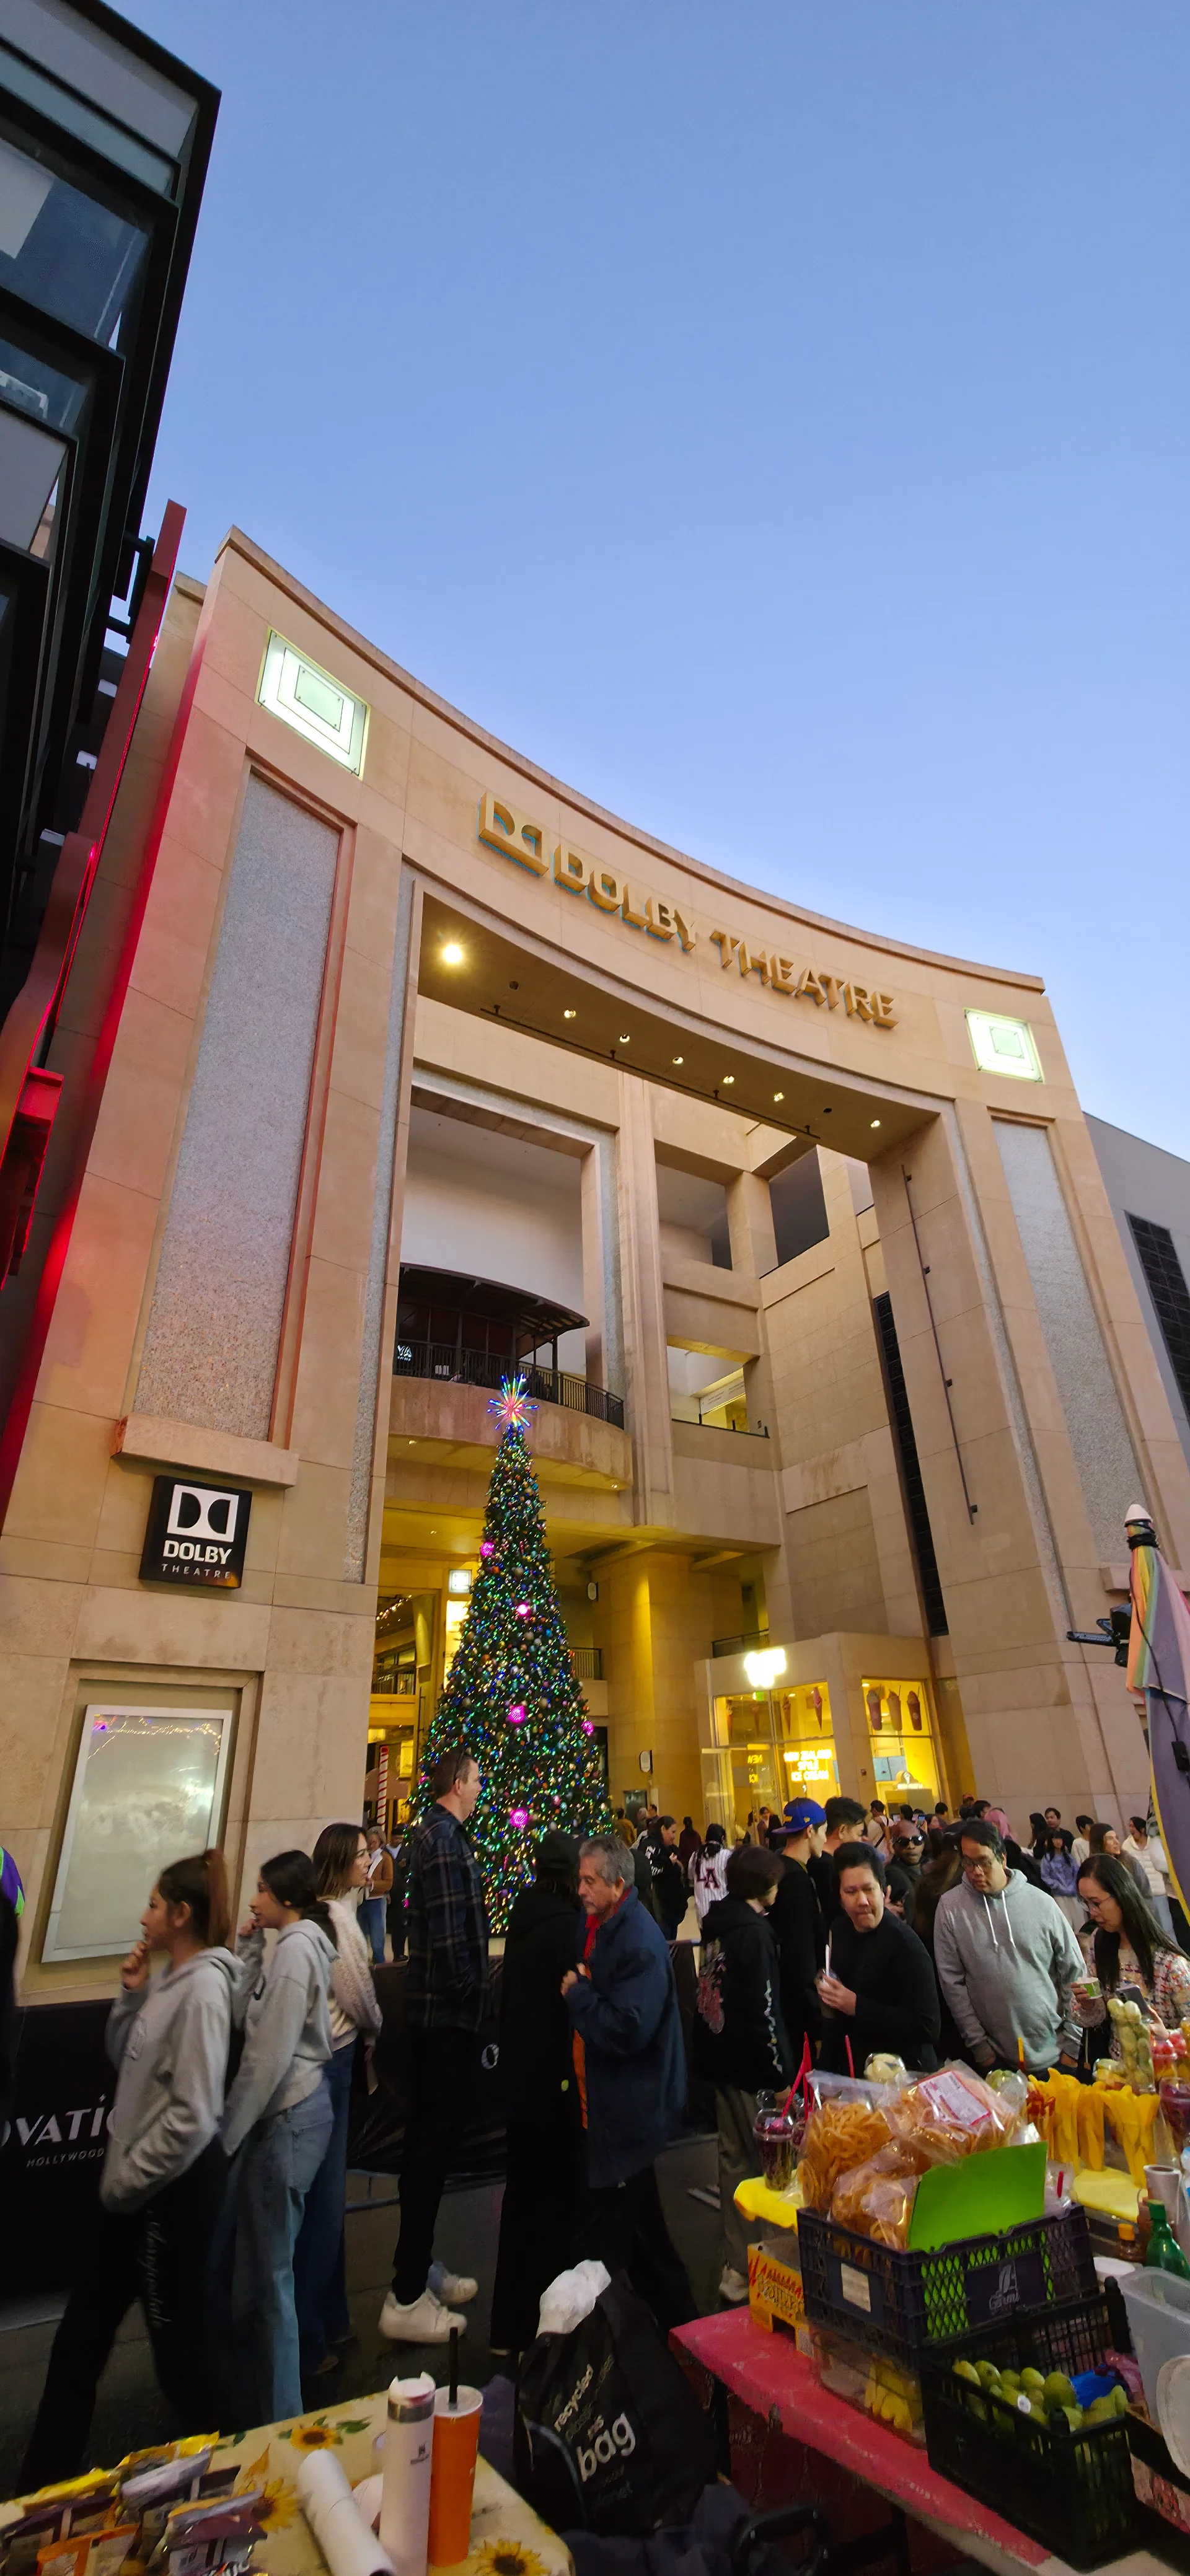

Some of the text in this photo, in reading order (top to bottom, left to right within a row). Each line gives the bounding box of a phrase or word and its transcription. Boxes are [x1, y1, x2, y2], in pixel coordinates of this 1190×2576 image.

[553, 844, 899, 1029] DOLBY THEATRE
[162, 1540, 232, 1565] DOLBY
[162, 1563, 231, 1579] THEATRE
[25, 2147, 105, 2168] HOLLYWOOD
[576, 2412, 636, 2482] bag
